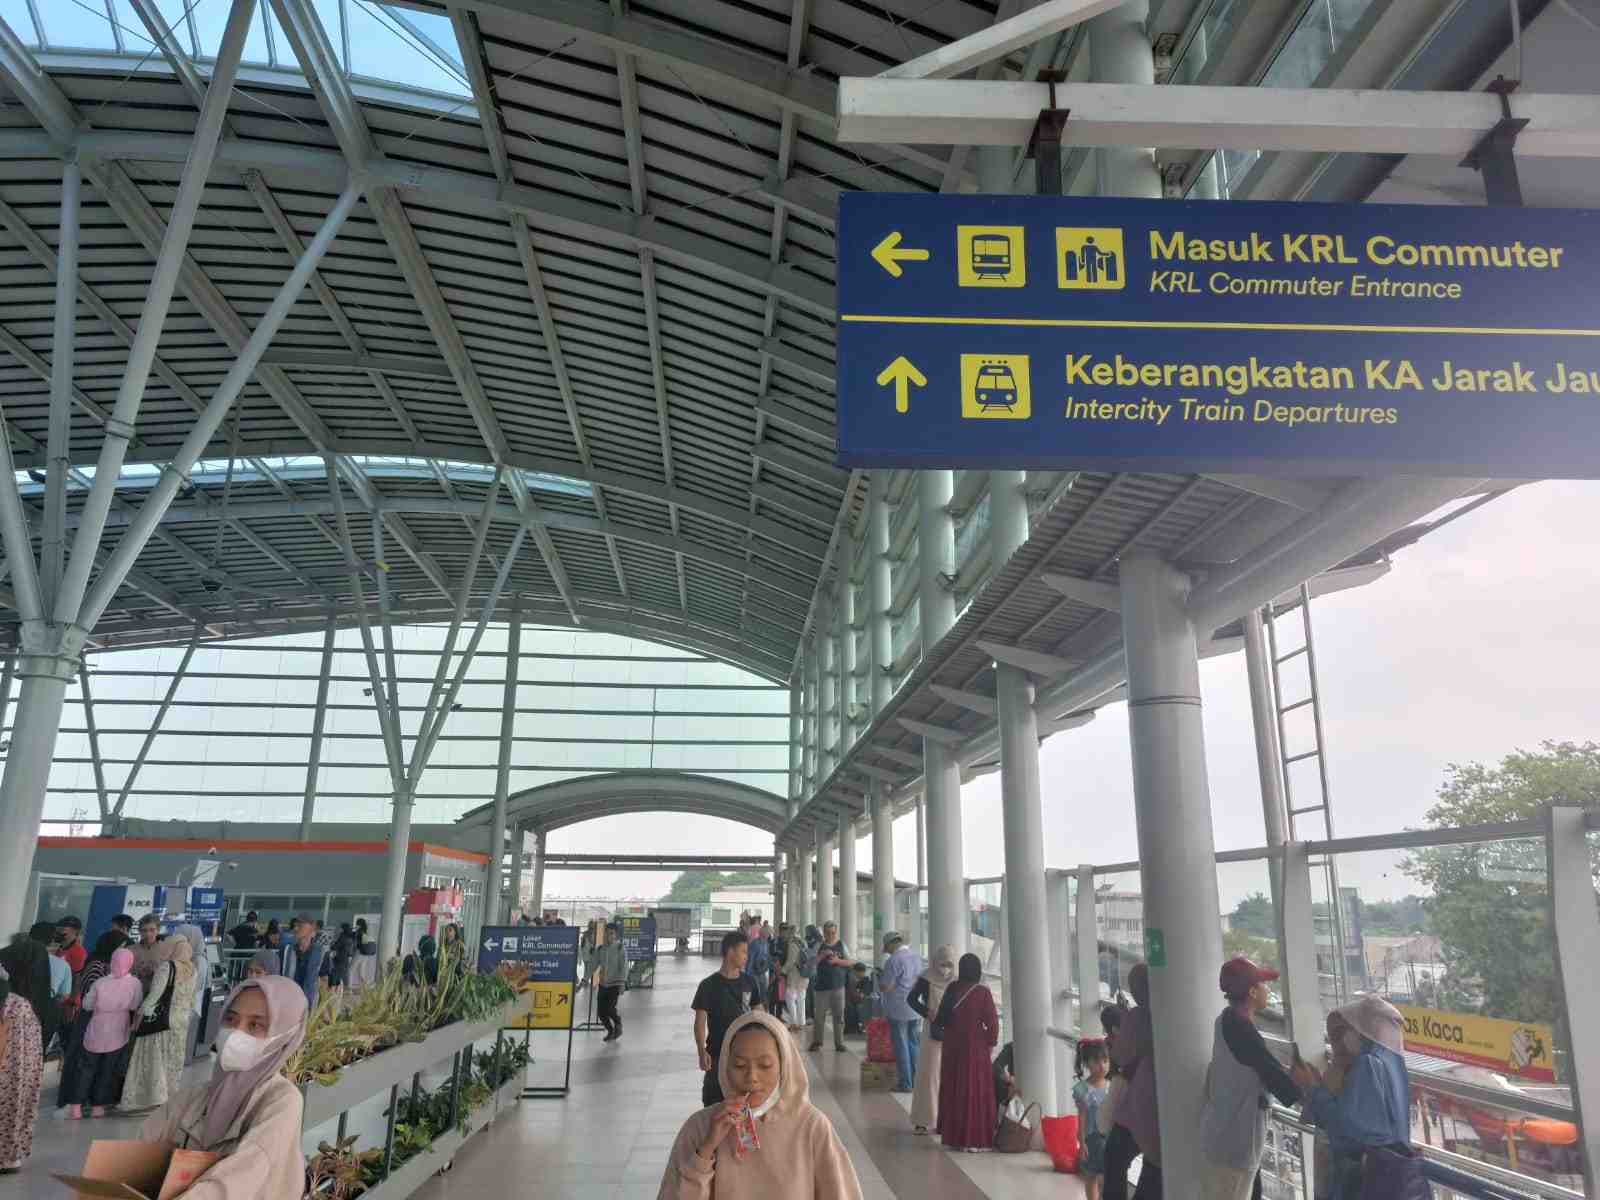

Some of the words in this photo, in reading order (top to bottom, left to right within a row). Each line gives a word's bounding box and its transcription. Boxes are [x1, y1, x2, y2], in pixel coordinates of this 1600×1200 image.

[1147, 229, 1273, 262] Masuk
[1281, 232, 1359, 264] KRL
[1366, 235, 1563, 270] Commuter
[1150, 271, 1201, 293] KRL
[1209, 271, 1342, 296] Commuter
[1350, 275, 1462, 298] Entrance
[1064, 353, 1355, 395] Keberangkatan
[1364, 359, 1424, 390] KA
[1432, 361, 1537, 392] Jarak
[1064, 396, 1171, 425] Intercity
[1180, 397, 1245, 422] Train
[1252, 400, 1398, 427] Departures
[1422, 1015, 1464, 1044] Kaca
